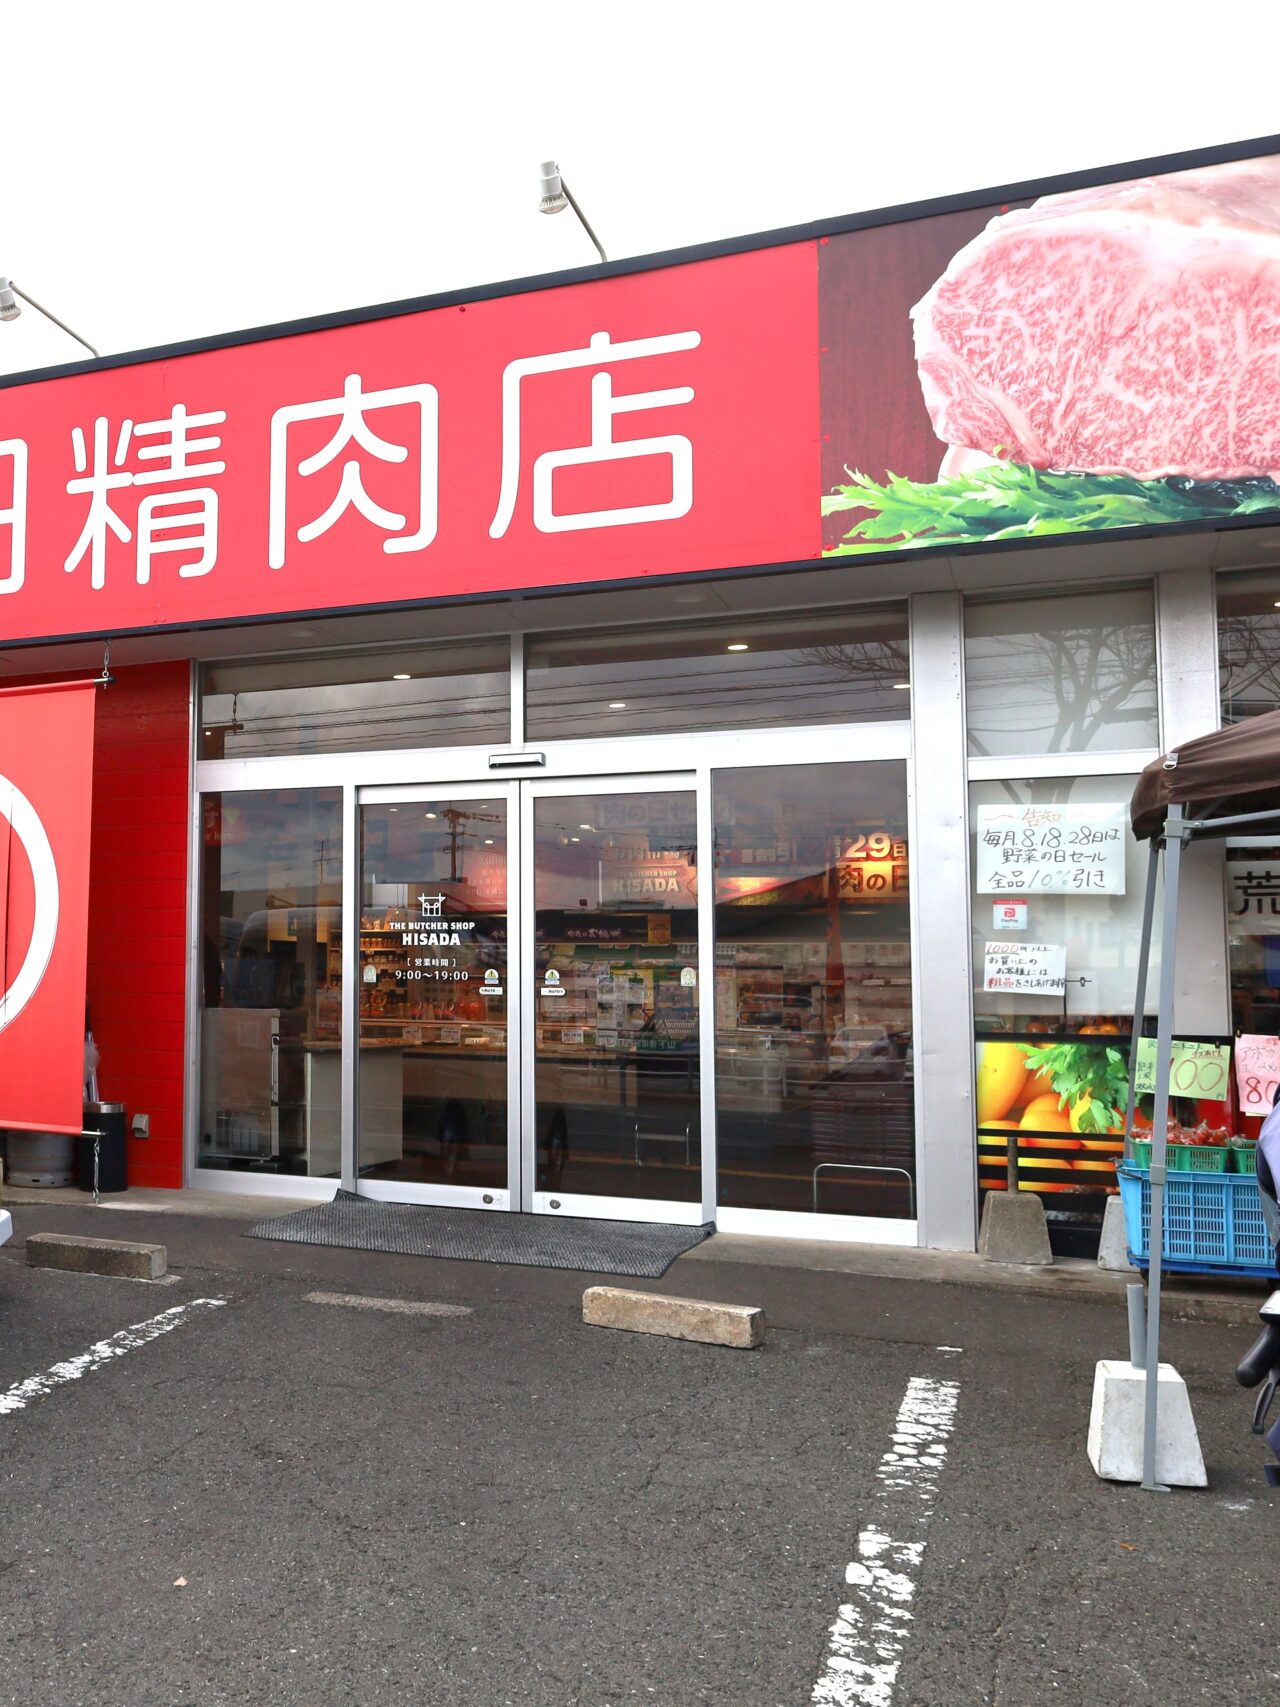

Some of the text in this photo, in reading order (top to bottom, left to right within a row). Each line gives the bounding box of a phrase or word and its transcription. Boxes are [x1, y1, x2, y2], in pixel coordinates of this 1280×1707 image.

[1001, 848, 1108, 864] 野菜の日セール
[615, 878, 679, 892] HISADA
[988, 868, 1106, 890] 全品10%引き
[389, 922, 476, 930] THE BUTCHER SHOP
[401, 933, 461, 946] HISADA
